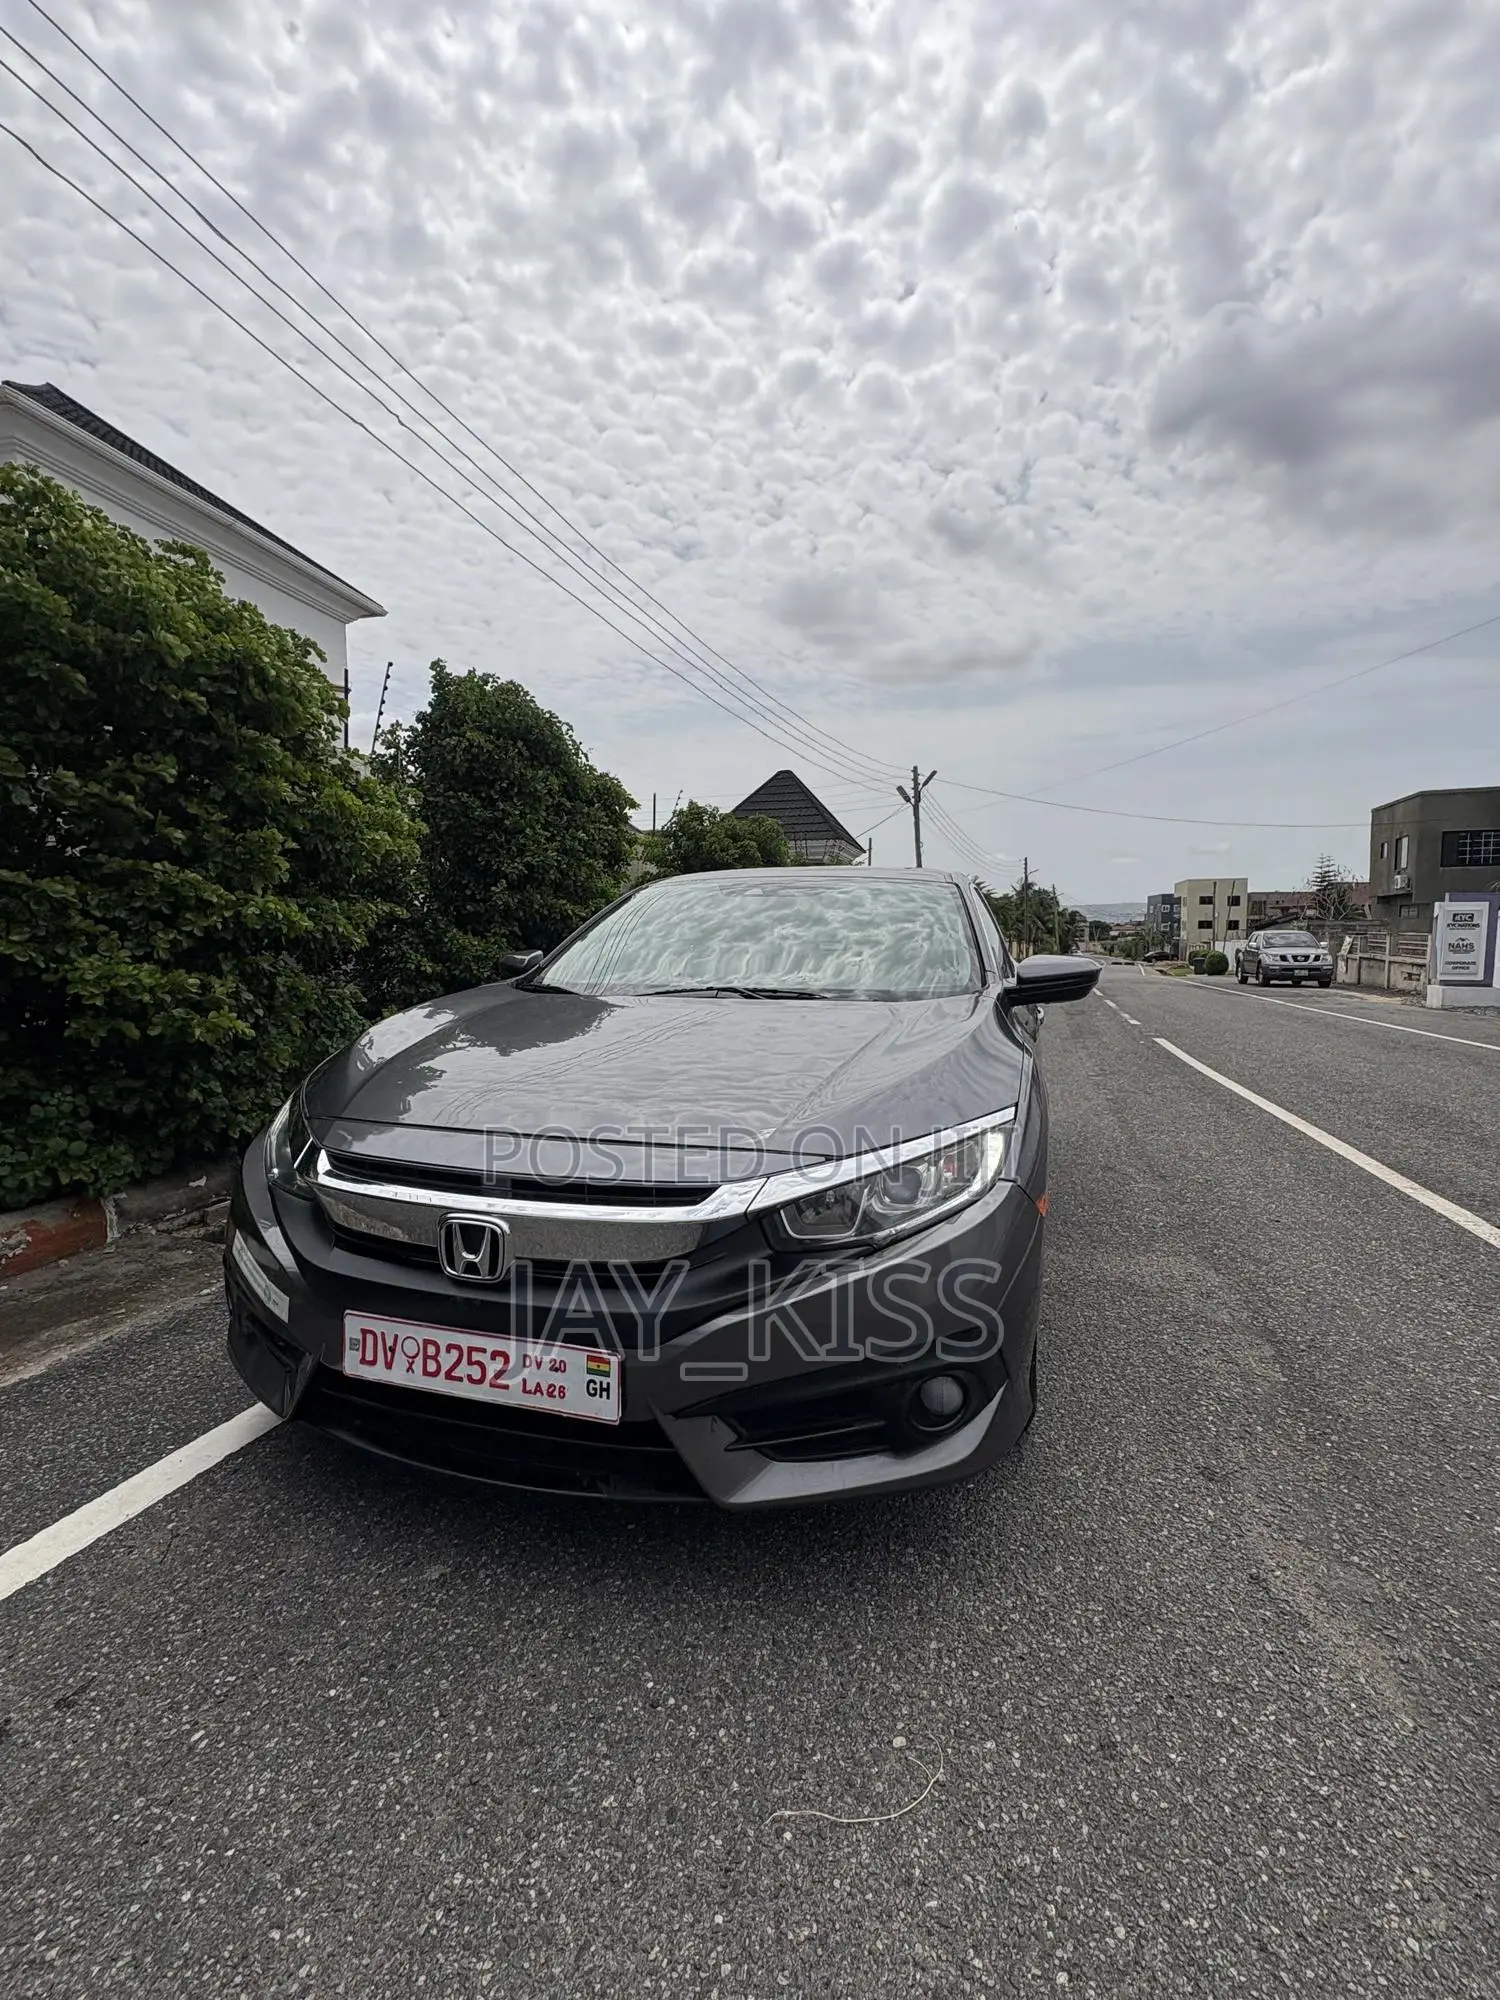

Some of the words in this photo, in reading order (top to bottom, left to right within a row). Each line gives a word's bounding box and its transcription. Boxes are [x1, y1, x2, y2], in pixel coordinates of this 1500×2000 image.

[1448, 942, 1475, 950] NAHS
[522, 1353, 543, 1370] DV
[548, 1358, 567, 1374] 20
[585, 1378, 611, 1400] GH
